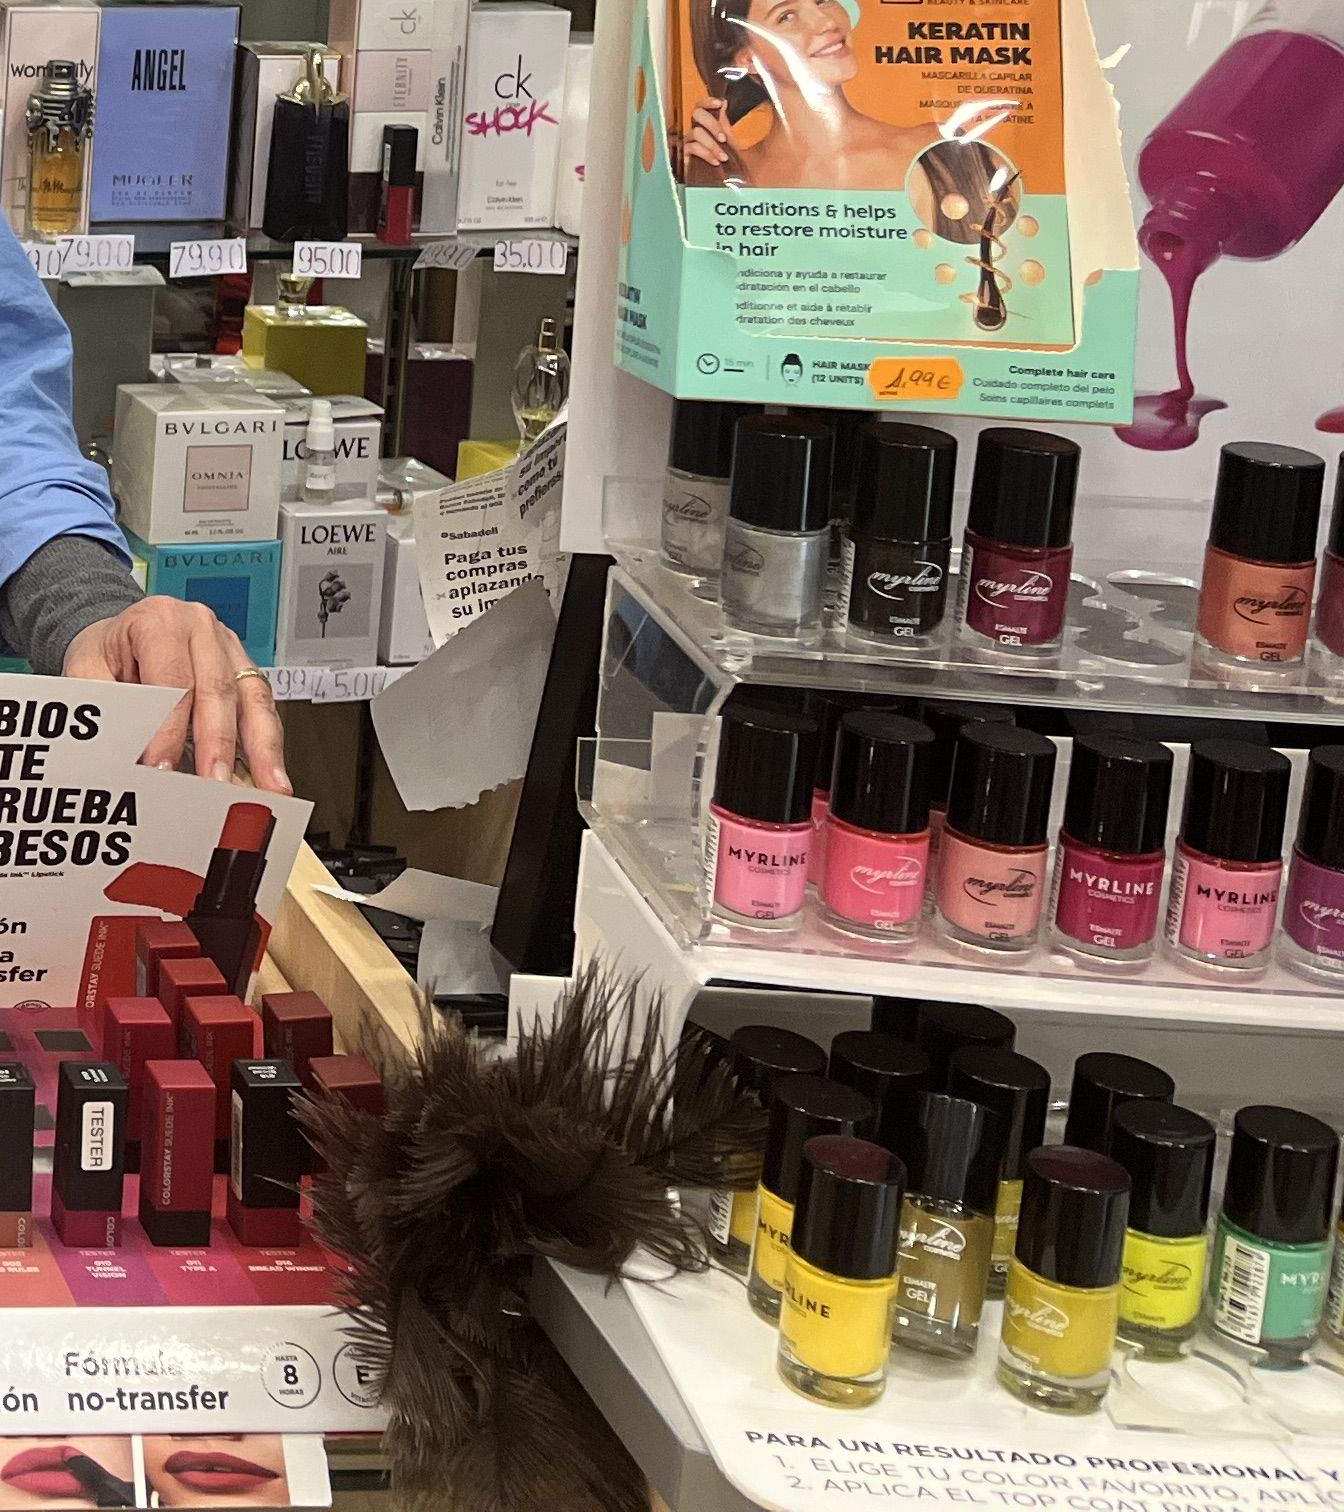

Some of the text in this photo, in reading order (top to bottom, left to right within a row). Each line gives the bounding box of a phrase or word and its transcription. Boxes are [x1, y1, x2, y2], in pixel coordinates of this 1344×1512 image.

[908, 21, 1030, 40] KERATIN
[875, 45, 1032, 65] HAIR MASK
[131, 49, 186, 91] ANGEL
[494, 54, 532, 102] ck
[466, 100, 558, 137] SHOCK
[714, 201, 896, 220] Conditions & helps
[715, 223, 907, 241] to restore moisture
[739, 242, 778, 257] hair
[1009, 365, 1116, 380] Complete hair care
[166, 421, 279, 436] BVLGARI
[192, 470, 246, 483] OMNIA
[301, 523, 376, 544] LOEWE
[449, 527, 498, 540] Sabadell
[164, 553, 274, 569] BVLGARI
[444, 545, 527, 565] Paga tus
[446, 559, 527, 581] compras
[728, 845, 807, 868] MYRLINE
[1069, 867, 1154, 896] MYRLINE
[1196, 884, 1277, 906] MYRLINE
[90, 1105, 104, 1168] TESTER
[283, 1364, 299, 1385] 8
[68, 1385, 229, 1411] no-transfer
[745, 1430, 1340, 1483] PARA UN RESULTADO PROFESIONAL Y
